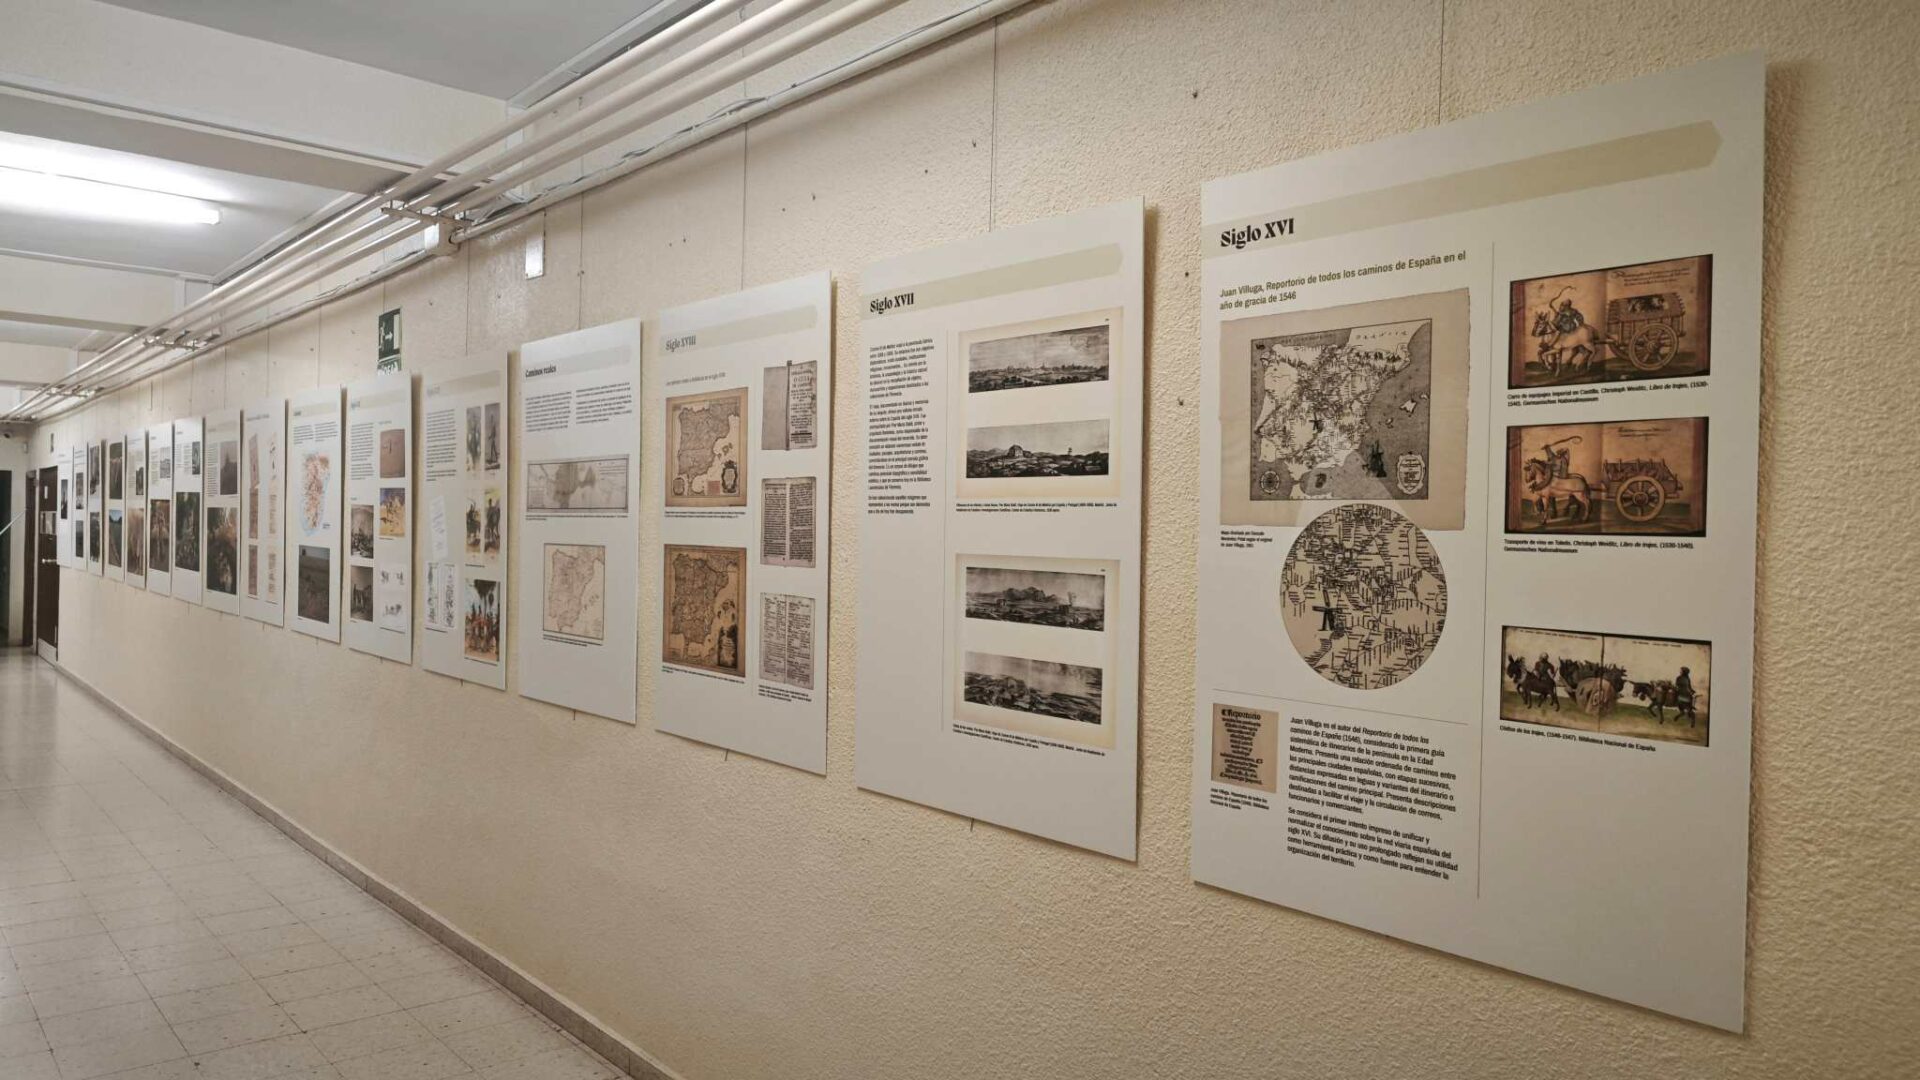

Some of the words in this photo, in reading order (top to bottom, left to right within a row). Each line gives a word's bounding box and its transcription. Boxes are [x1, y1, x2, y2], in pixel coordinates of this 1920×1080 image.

[1221, 224, 1261, 249] Siglo
[1265, 218, 1294, 239] XVI
[1220, 288, 1236, 298] Juan
[1238, 284, 1264, 294] Villuga,
[1266, 277, 1305, 291] Reportorio
[1307, 274, 1317, 284] de
[1319, 271, 1341, 282] todos
[1344, 269, 1356, 278] los
[1358, 263, 1393, 277] caminos
[1396, 260, 1405, 270] de
[1409, 254, 1441, 269] España
[1444, 254, 1455, 262] en
[1457, 251, 1465, 260] el
[870, 297, 892, 314] Siglo
[894, 293, 914, 307] XVII
[1220, 301, 1232, 310] año
[1234, 299, 1242, 308] de
[1244, 295, 1267, 308] gracia
[1268, 294, 1277, 304] de
[1280, 291, 1296, 302] 1546
[666, 339, 680, 352] Siglo
[681, 335, 696, 347] XVIII
